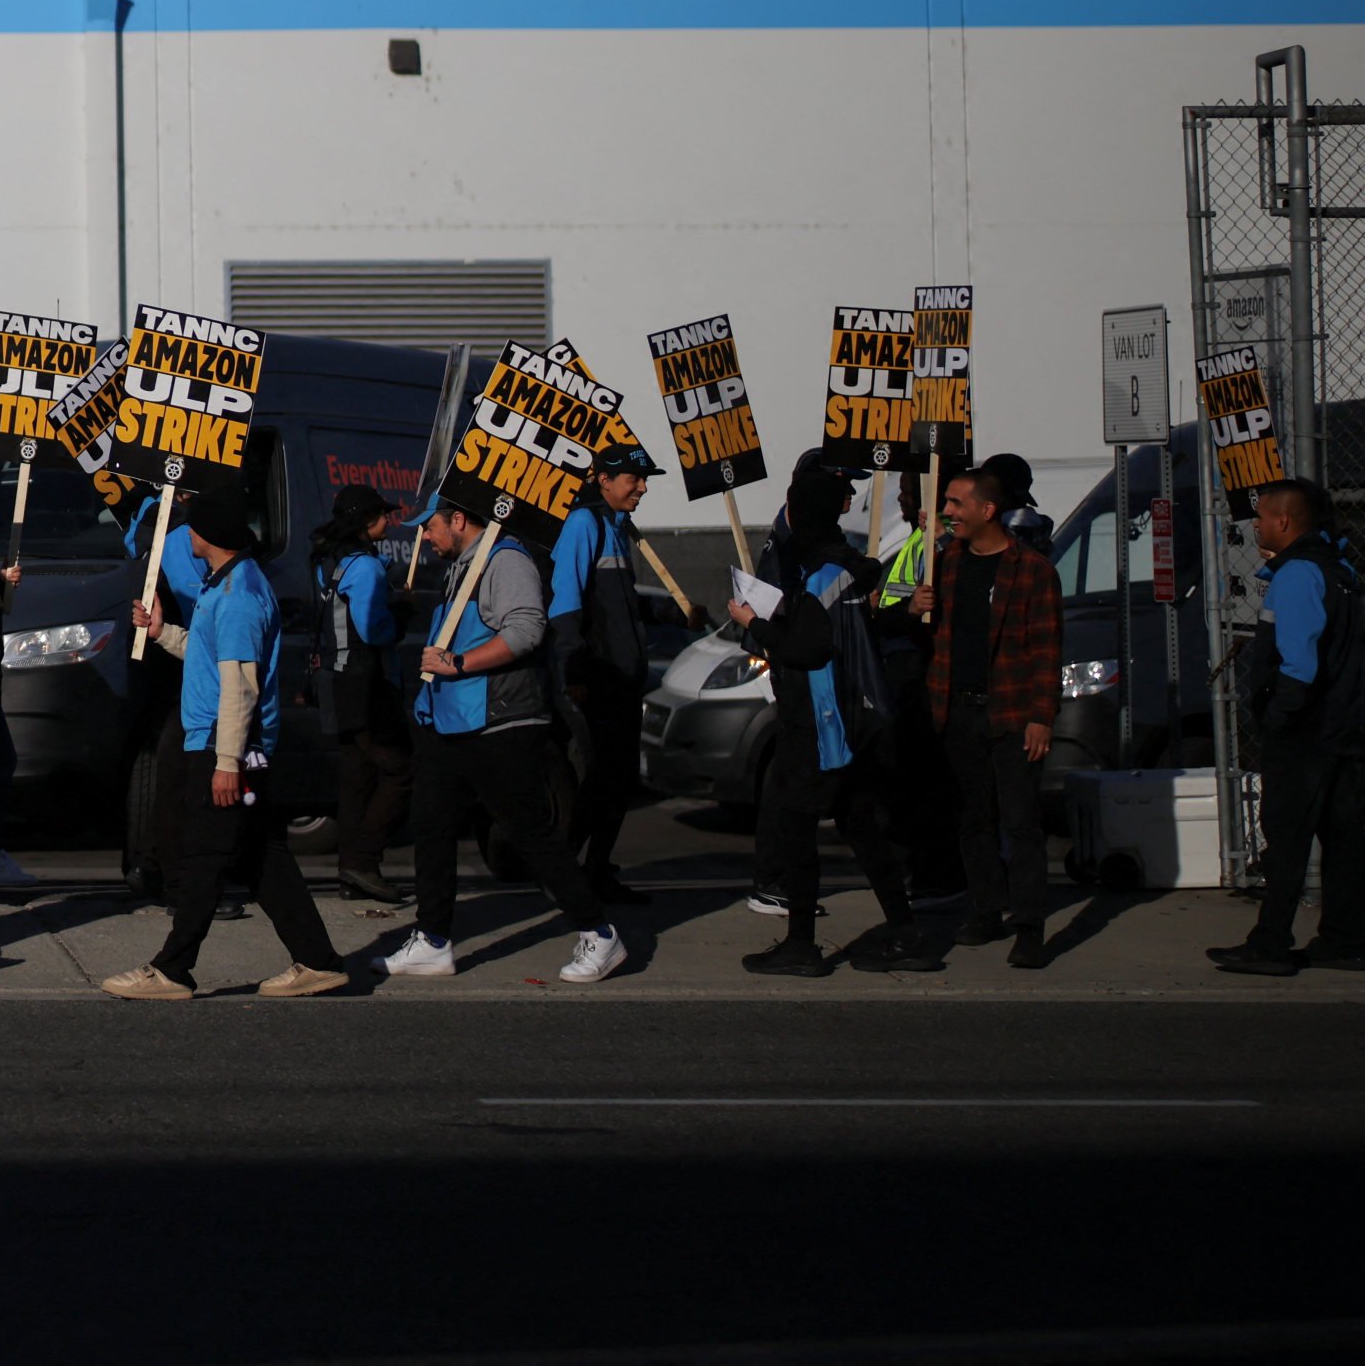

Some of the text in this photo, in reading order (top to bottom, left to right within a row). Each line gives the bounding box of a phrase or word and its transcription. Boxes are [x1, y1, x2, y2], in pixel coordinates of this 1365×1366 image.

[839, 309, 914, 333] TANN
[916, 287, 969, 310] TANNC
[1226, 296, 1265, 318] amazon
[141, 307, 259, 353] TANNC
[651, 318, 728, 356] TANNC
[836, 333, 914, 367] AMAZ
[916, 312, 968, 346] AMAZON
[1113, 334, 1155, 361] VAN LOT
[134, 332, 256, 390] AMAZON
[510, 343, 617, 413] TANNC
[661, 340, 738, 393] AMAZON
[914, 348, 968, 378] ULP
[1196, 348, 1254, 381] TANNC
[49, 344, 129, 429] TANNC
[124, 366, 253, 416] ULP
[490, 369, 608, 448] AMAZON
[664, 377, 745, 423] ULP
[912, 378, 966, 422] STRIKE
[1131, 375, 1140, 417] B
[1204, 373, 1265, 417] AMAZON
[65, 372, 125, 451] AMAZ
[116, 397, 248, 468] STRIKE
[475, 398, 594, 469] ULP
[1209, 408, 1270, 447] ULP
[673, 405, 760, 469] STRIKE
[455, 428, 583, 521] STRIKE
[1218, 437, 1285, 491] STRIKE
